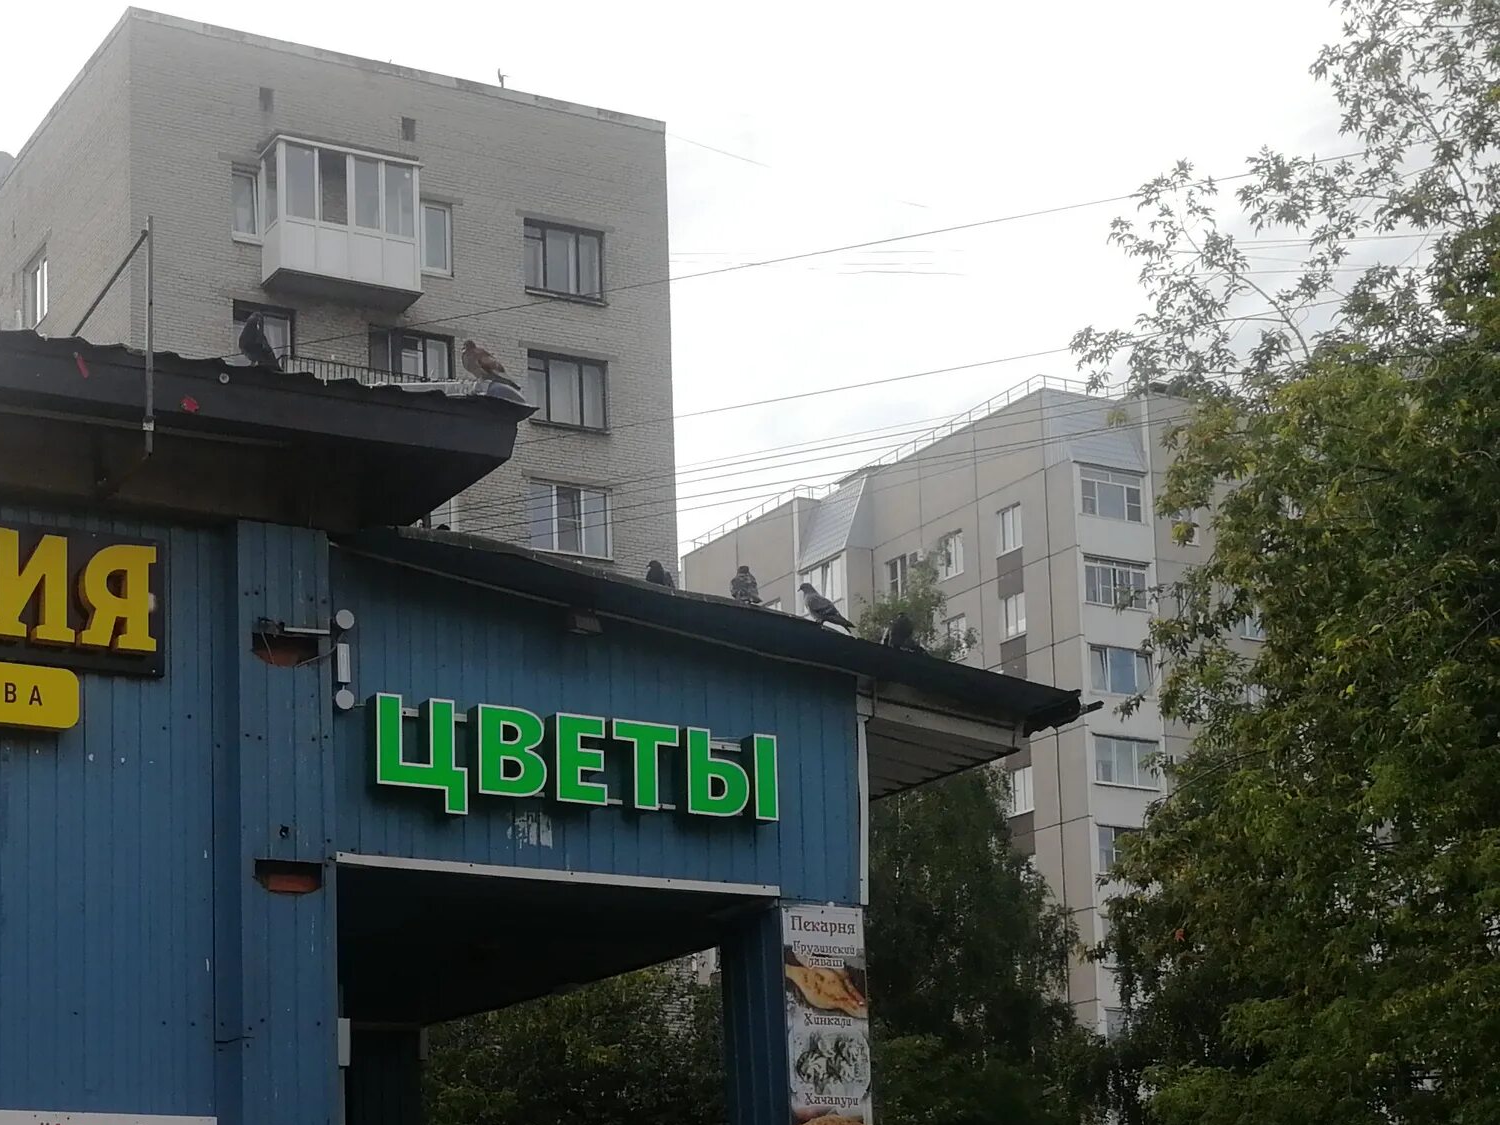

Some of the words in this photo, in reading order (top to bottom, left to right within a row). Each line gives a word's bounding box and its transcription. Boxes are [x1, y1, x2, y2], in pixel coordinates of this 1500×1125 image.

[376, 692, 779, 822] ЦВЕТЫ
[790, 914, 856, 936] Пекарня
[792, 940, 856, 955] Грузинский
[803, 1012, 852, 1029] Хинкали
[804, 1092, 859, 1109] Хачапури
